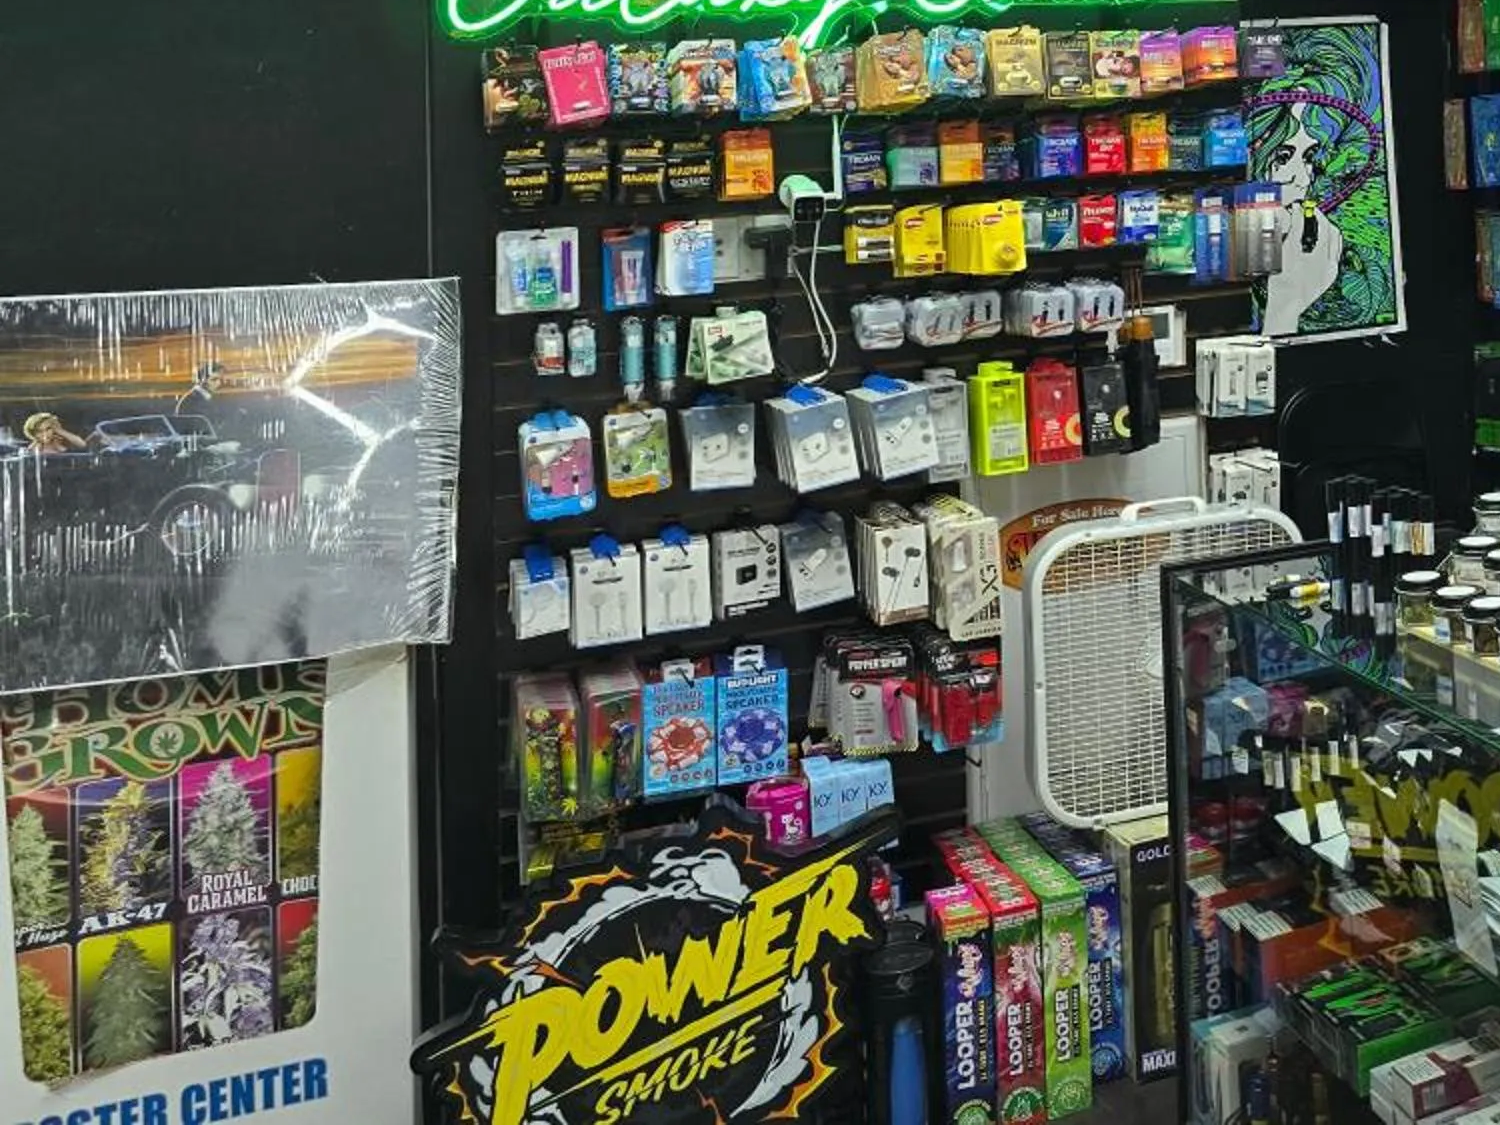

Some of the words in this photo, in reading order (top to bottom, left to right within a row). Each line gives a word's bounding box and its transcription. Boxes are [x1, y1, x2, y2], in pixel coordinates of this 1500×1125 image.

[78, 901, 168, 935] AK-47
[187, 886, 268, 914] CARAMEL
[201, 871, 253, 894] ROYAL
[490, 863, 872, 1125] POWER
[1055, 987, 1071, 1063] LOOPER
[594, 1015, 763, 1125] SMOKE
[955, 1000, 976, 1091] LOOPER
[1007, 1002, 1024, 1076] LOOPER
[1141, 1050, 1177, 1074] MAXI
[180, 1057, 329, 1125] CENTER
